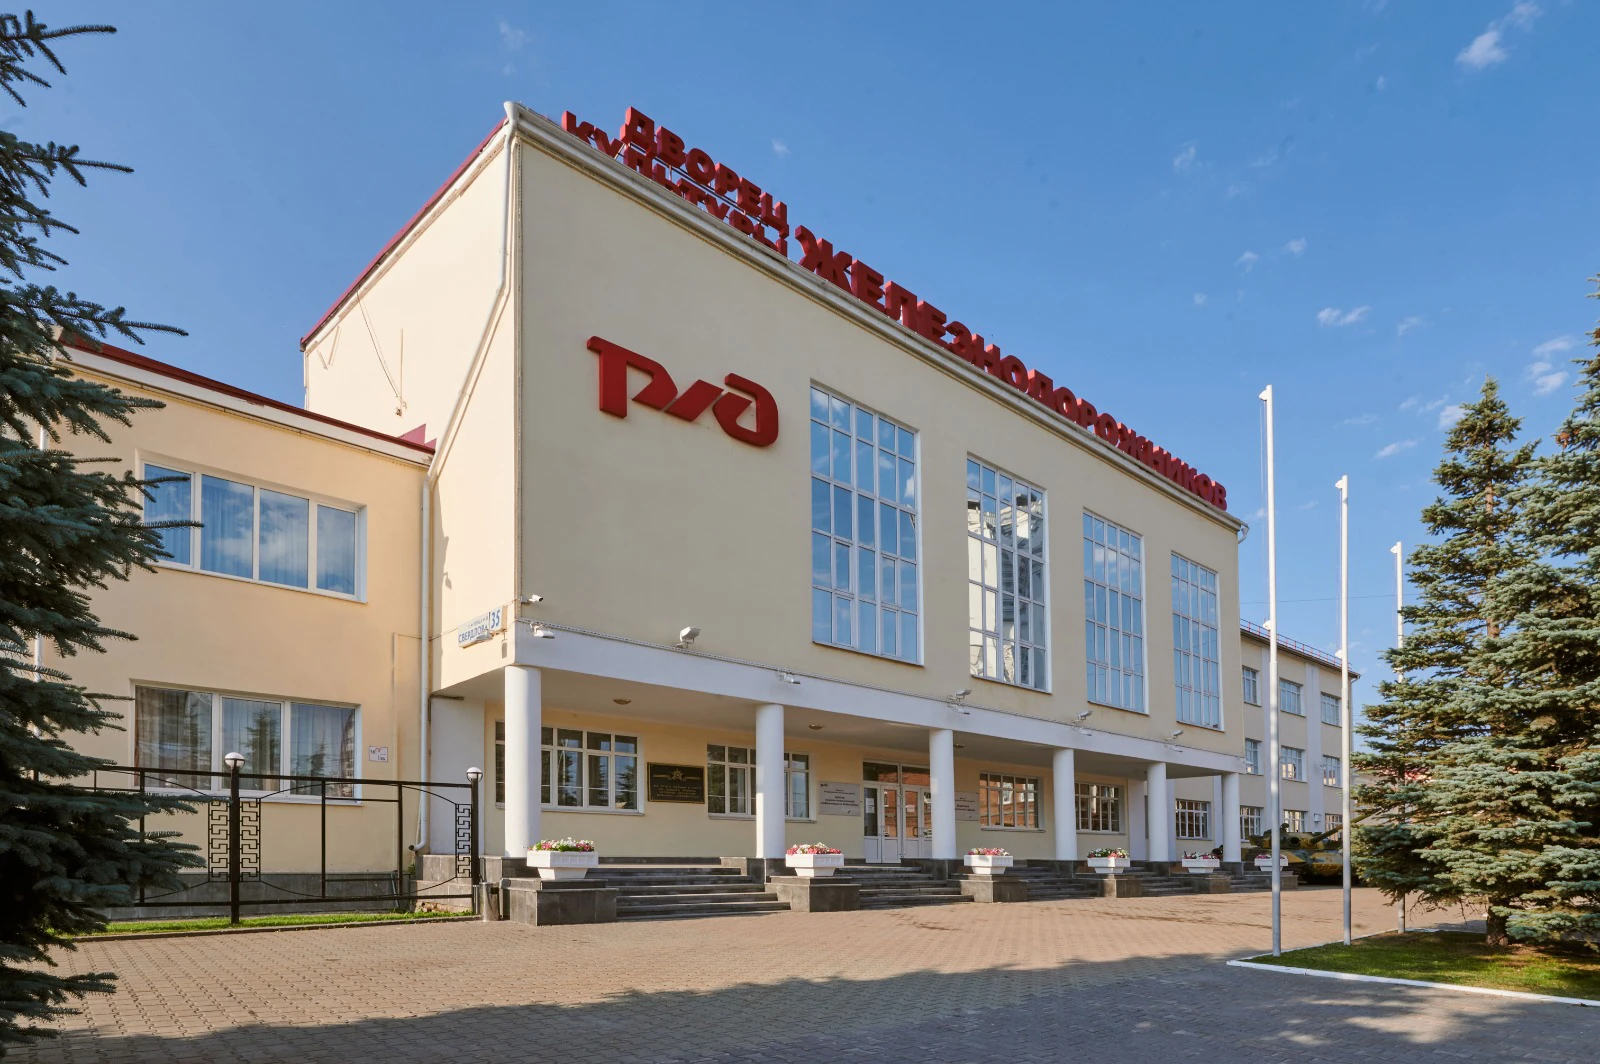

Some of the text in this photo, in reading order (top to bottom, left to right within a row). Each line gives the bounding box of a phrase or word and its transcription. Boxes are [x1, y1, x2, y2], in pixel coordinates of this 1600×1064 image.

[620, 106, 789, 239] ДВОРЕЦ
[795, 225, 1227, 511] ЖЕЛЕЗНОДОРОЖНИКОВ
[491, 609, 501, 629] 35
